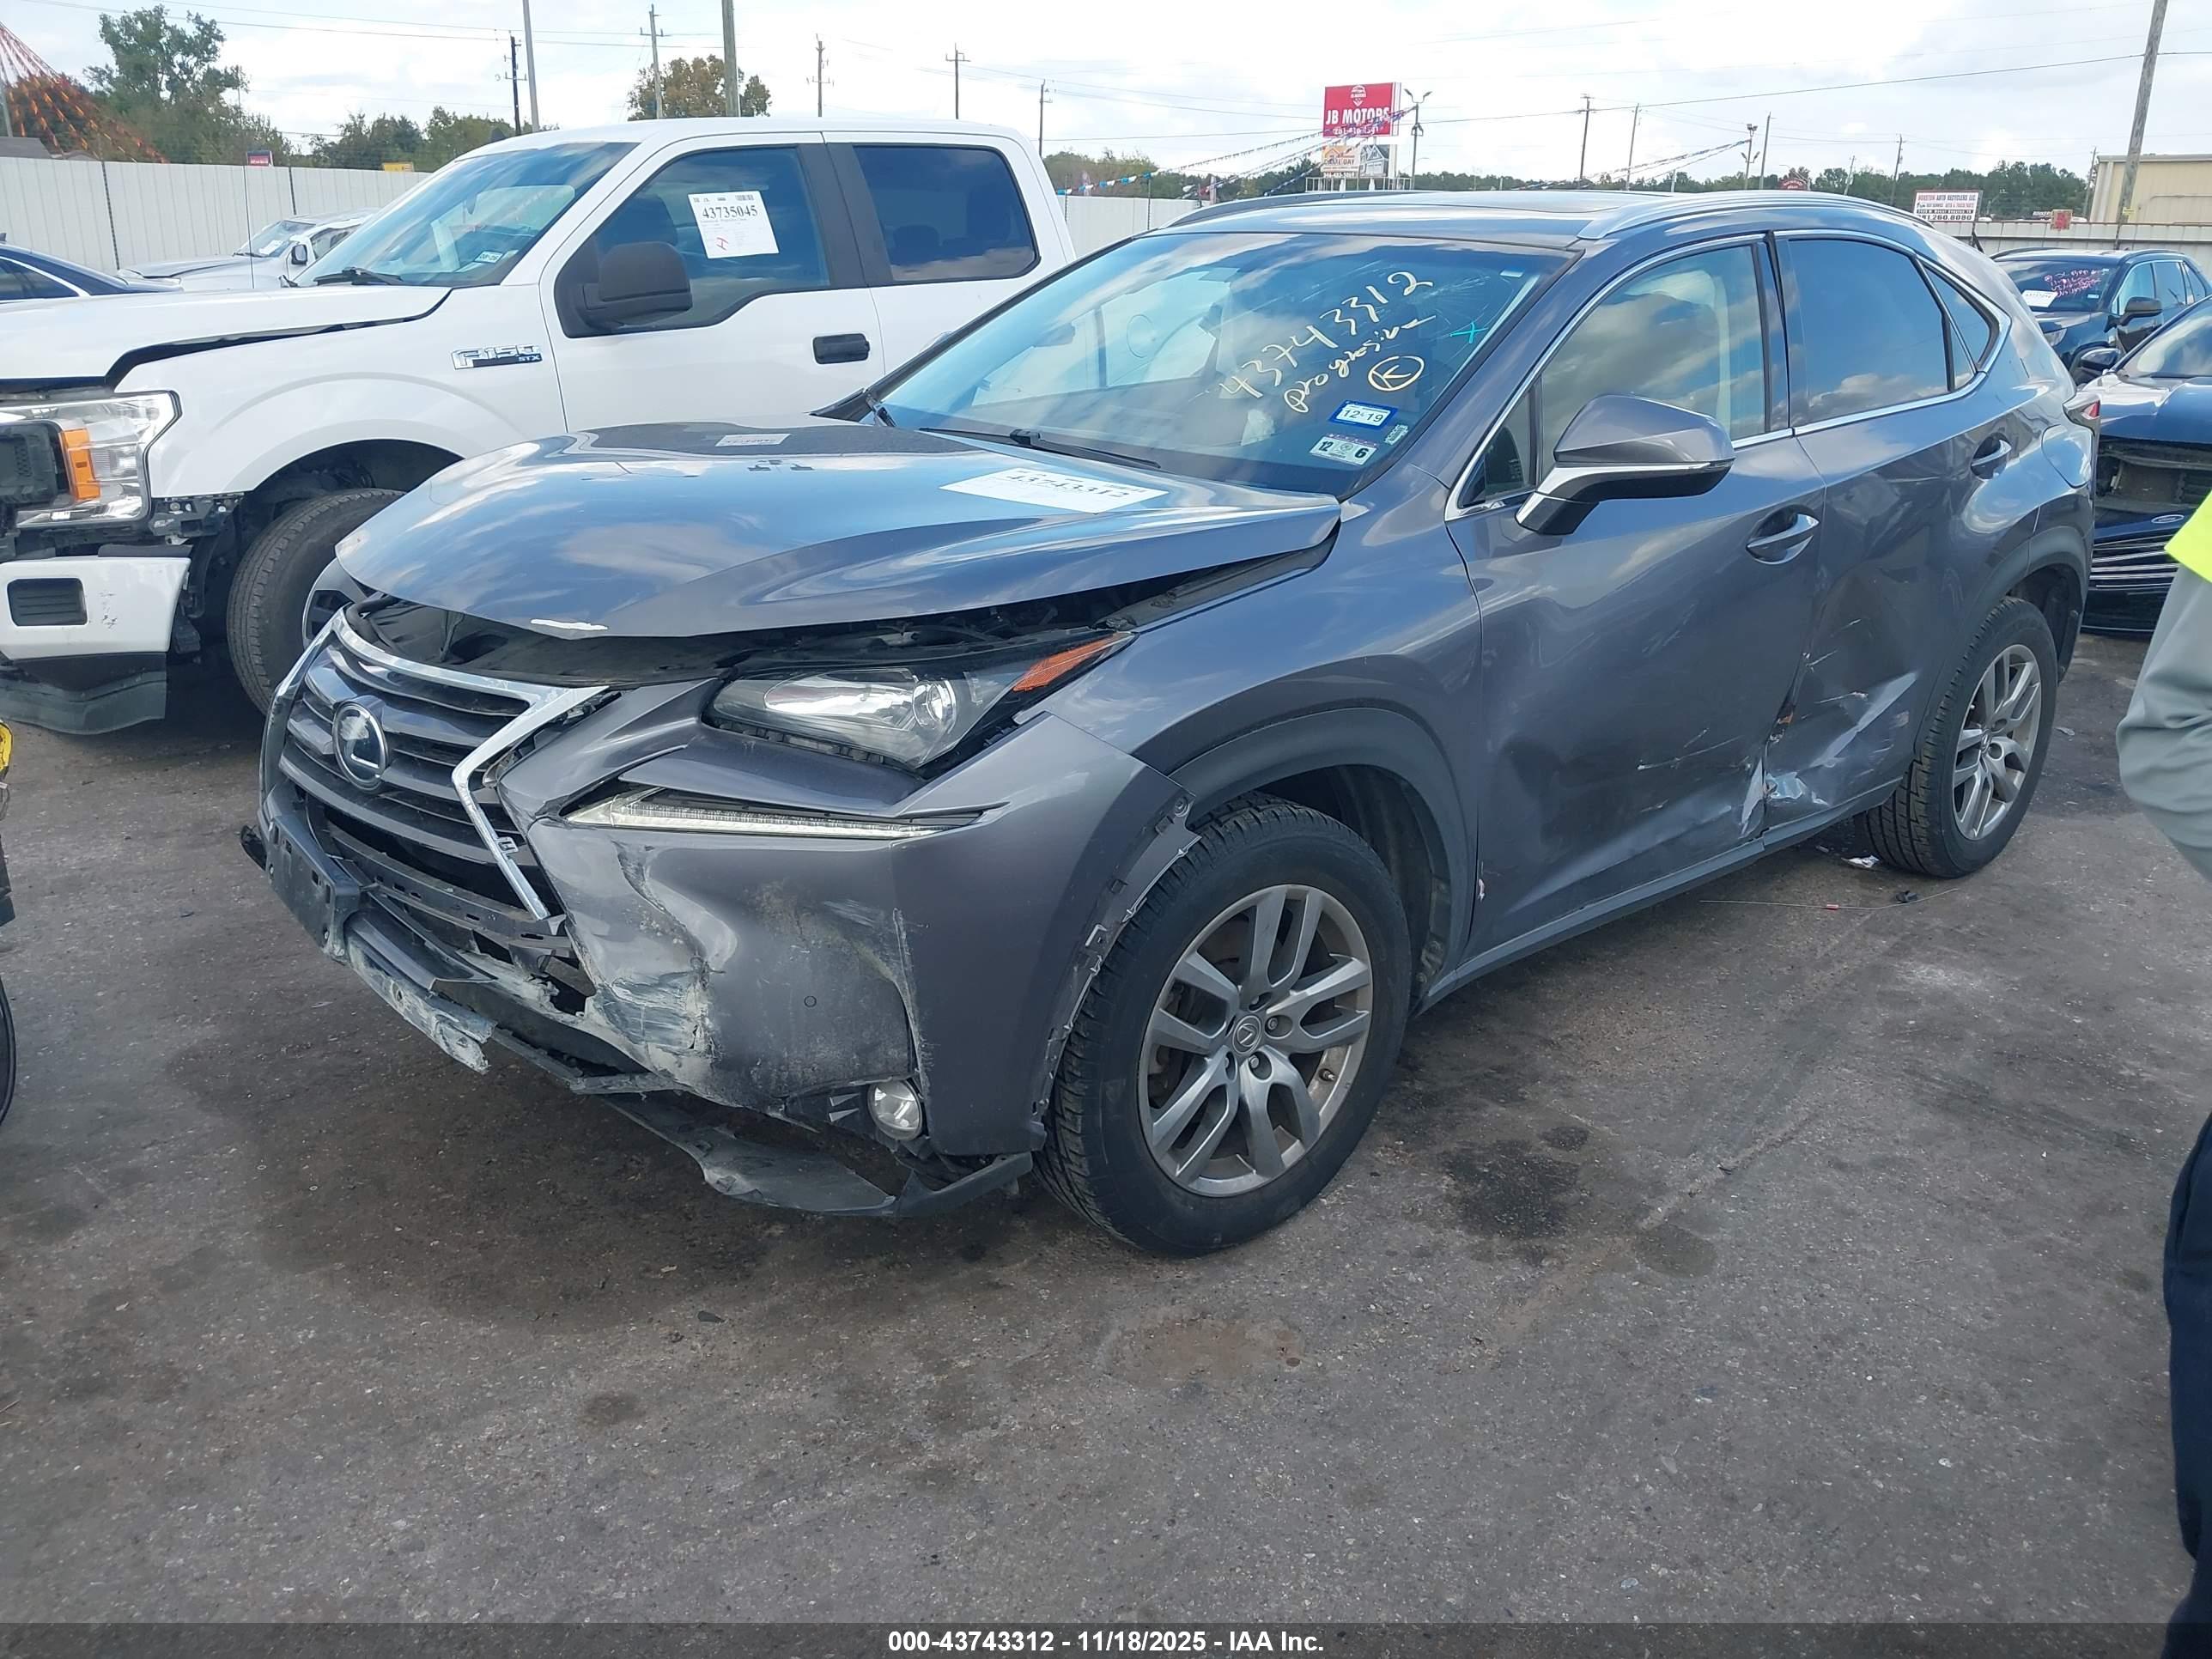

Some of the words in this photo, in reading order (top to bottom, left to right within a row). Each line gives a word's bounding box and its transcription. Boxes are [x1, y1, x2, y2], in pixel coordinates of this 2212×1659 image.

[1326, 109, 1339, 125] JB
[1341, 107, 1390, 125] MOTORS
[702, 205, 758, 219] 43735045
[1218, 270, 1434, 399] 43743312
[518, 355, 541, 363] STX
[1318, 441, 1334, 452] 12
[1354, 447, 1370, 459] 6
